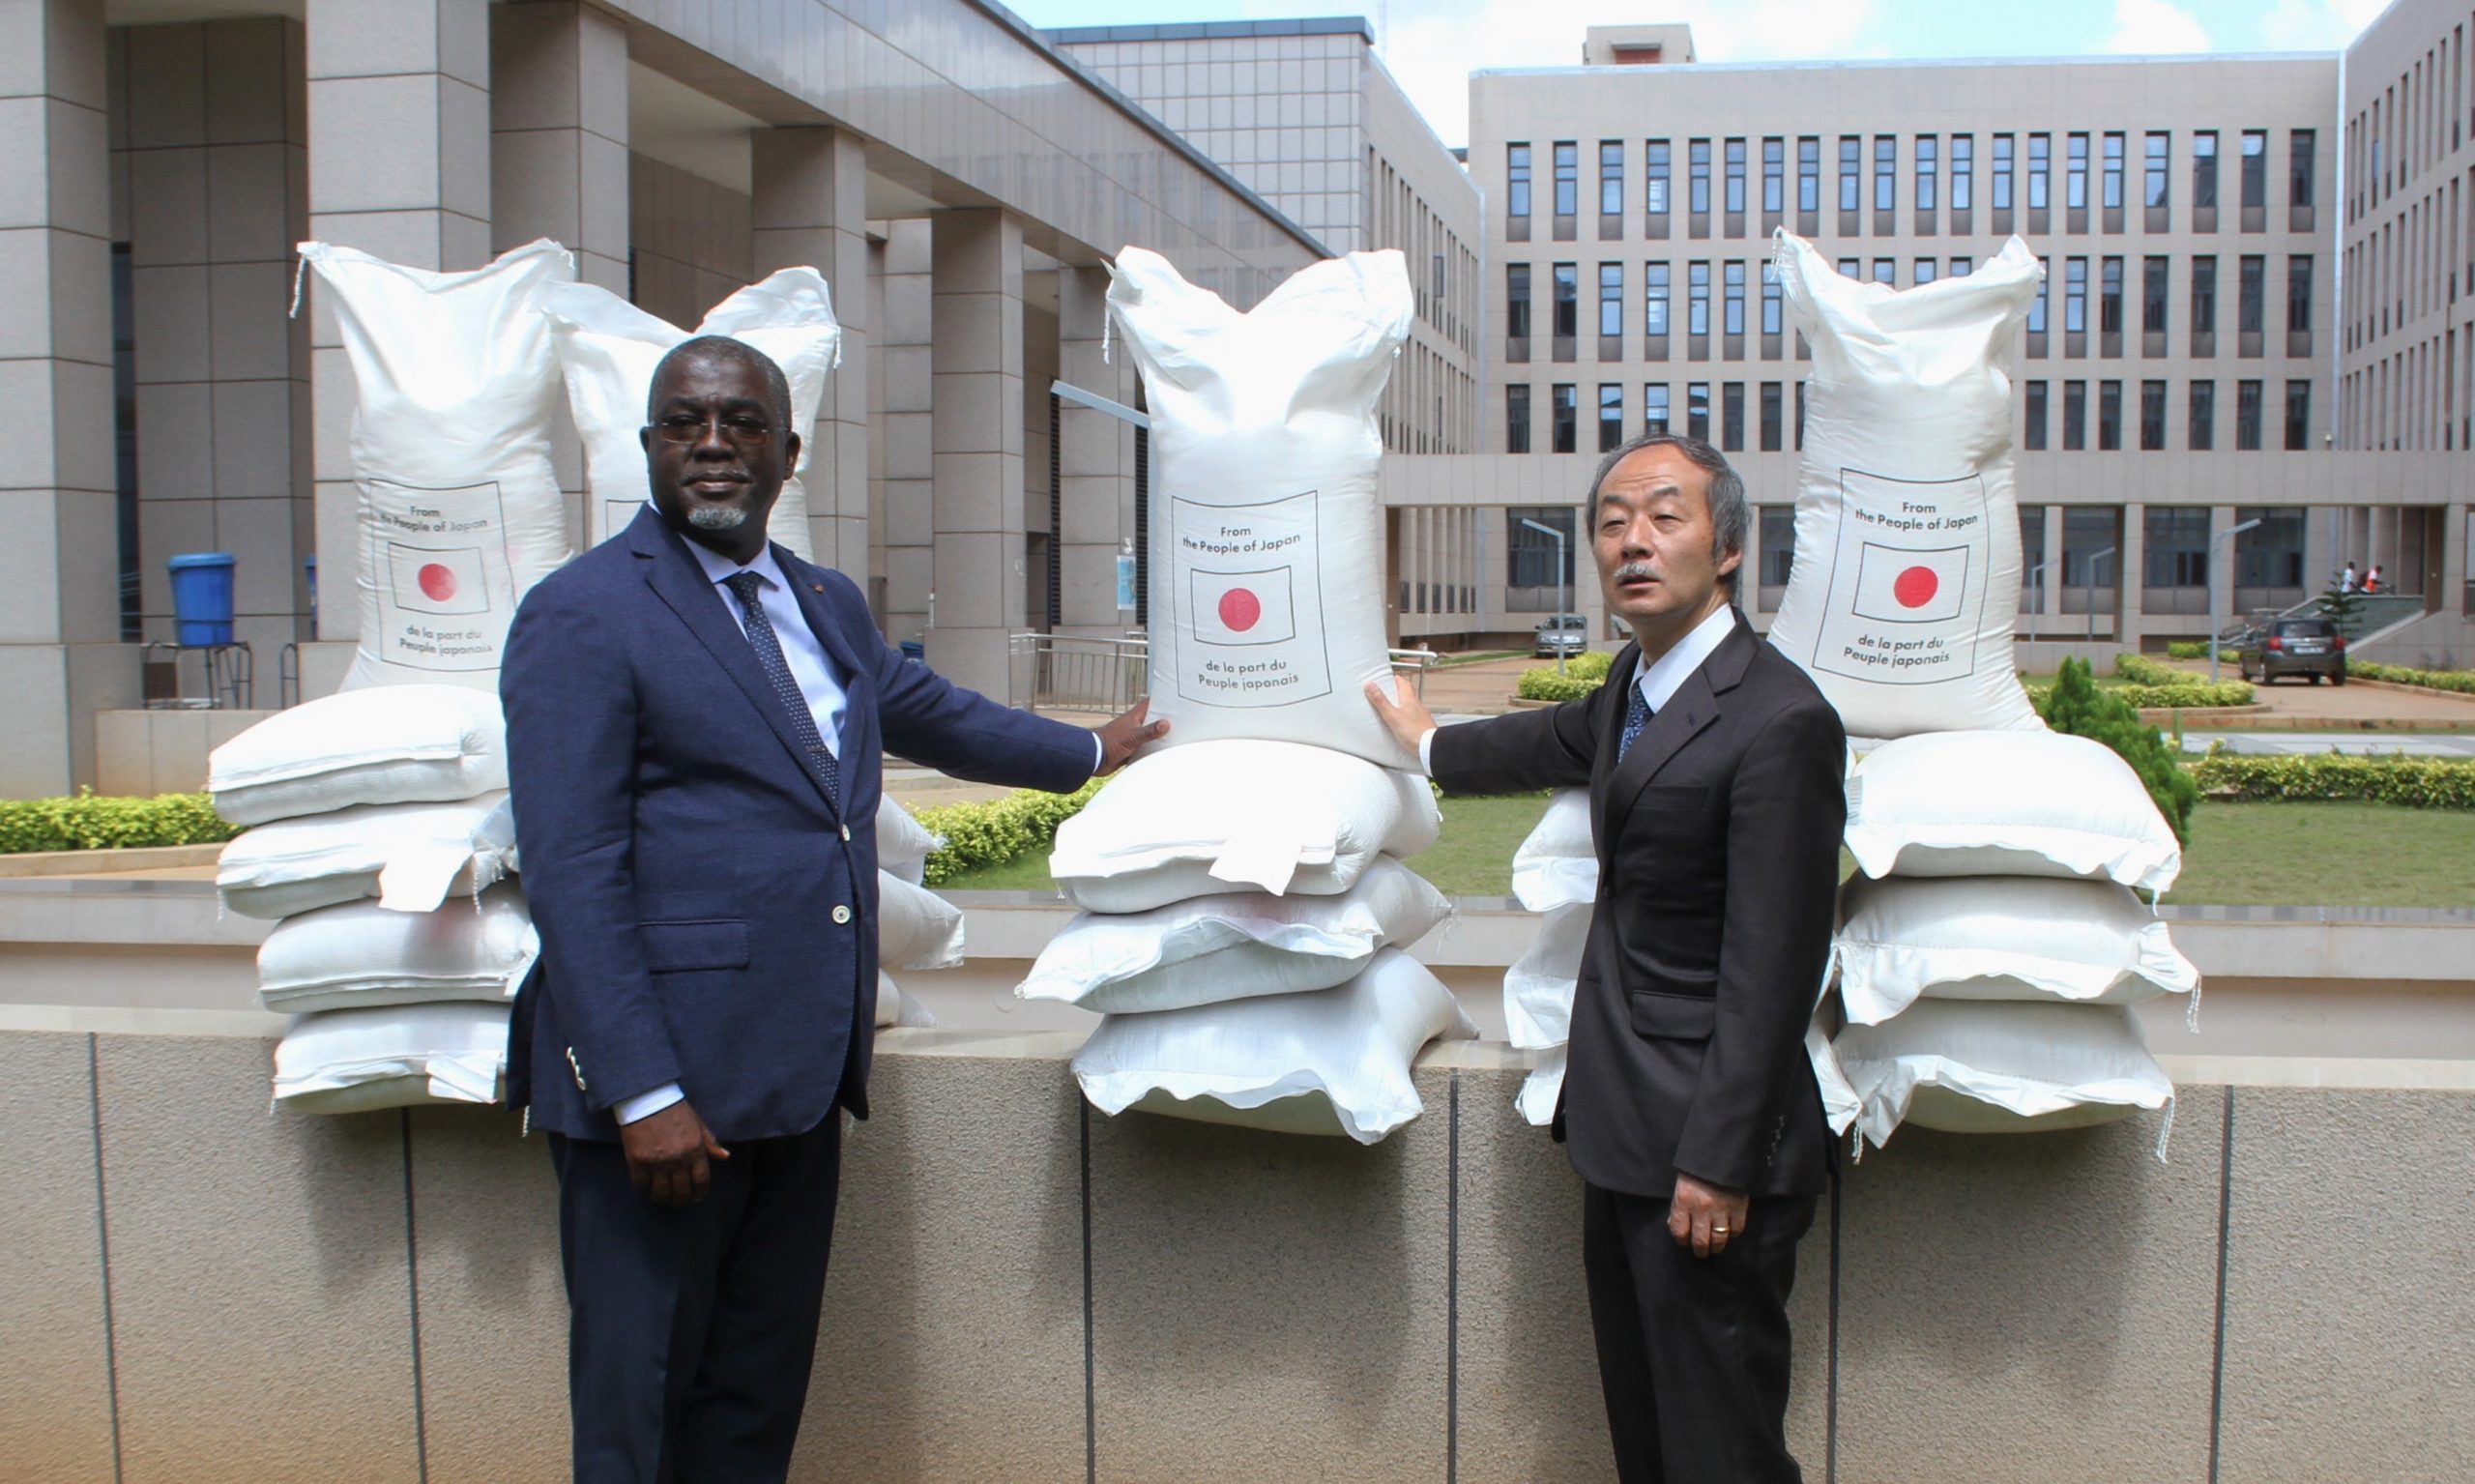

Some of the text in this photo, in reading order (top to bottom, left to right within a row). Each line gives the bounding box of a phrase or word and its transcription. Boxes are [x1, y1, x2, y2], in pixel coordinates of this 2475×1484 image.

[410, 506, 441, 517] From
[1902, 501, 1936, 514] From
[393, 516, 430, 533] People
[433, 521, 448, 532] of
[450, 519, 488, 533] Japan
[1855, 509, 1978, 532] the People of Japan
[1220, 526, 1252, 538] From
[1182, 534, 1301, 556] the People of Japan
[406, 625, 482, 643] de la part du
[1857, 633, 1944, 653] de la part du
[399, 637, 493, 656] Peuple japonais
[1843, 647, 1950, 668] Peuple japonais
[1206, 659, 1287, 676] de la part du
[1198, 672, 1299, 691] Peuple japonais
